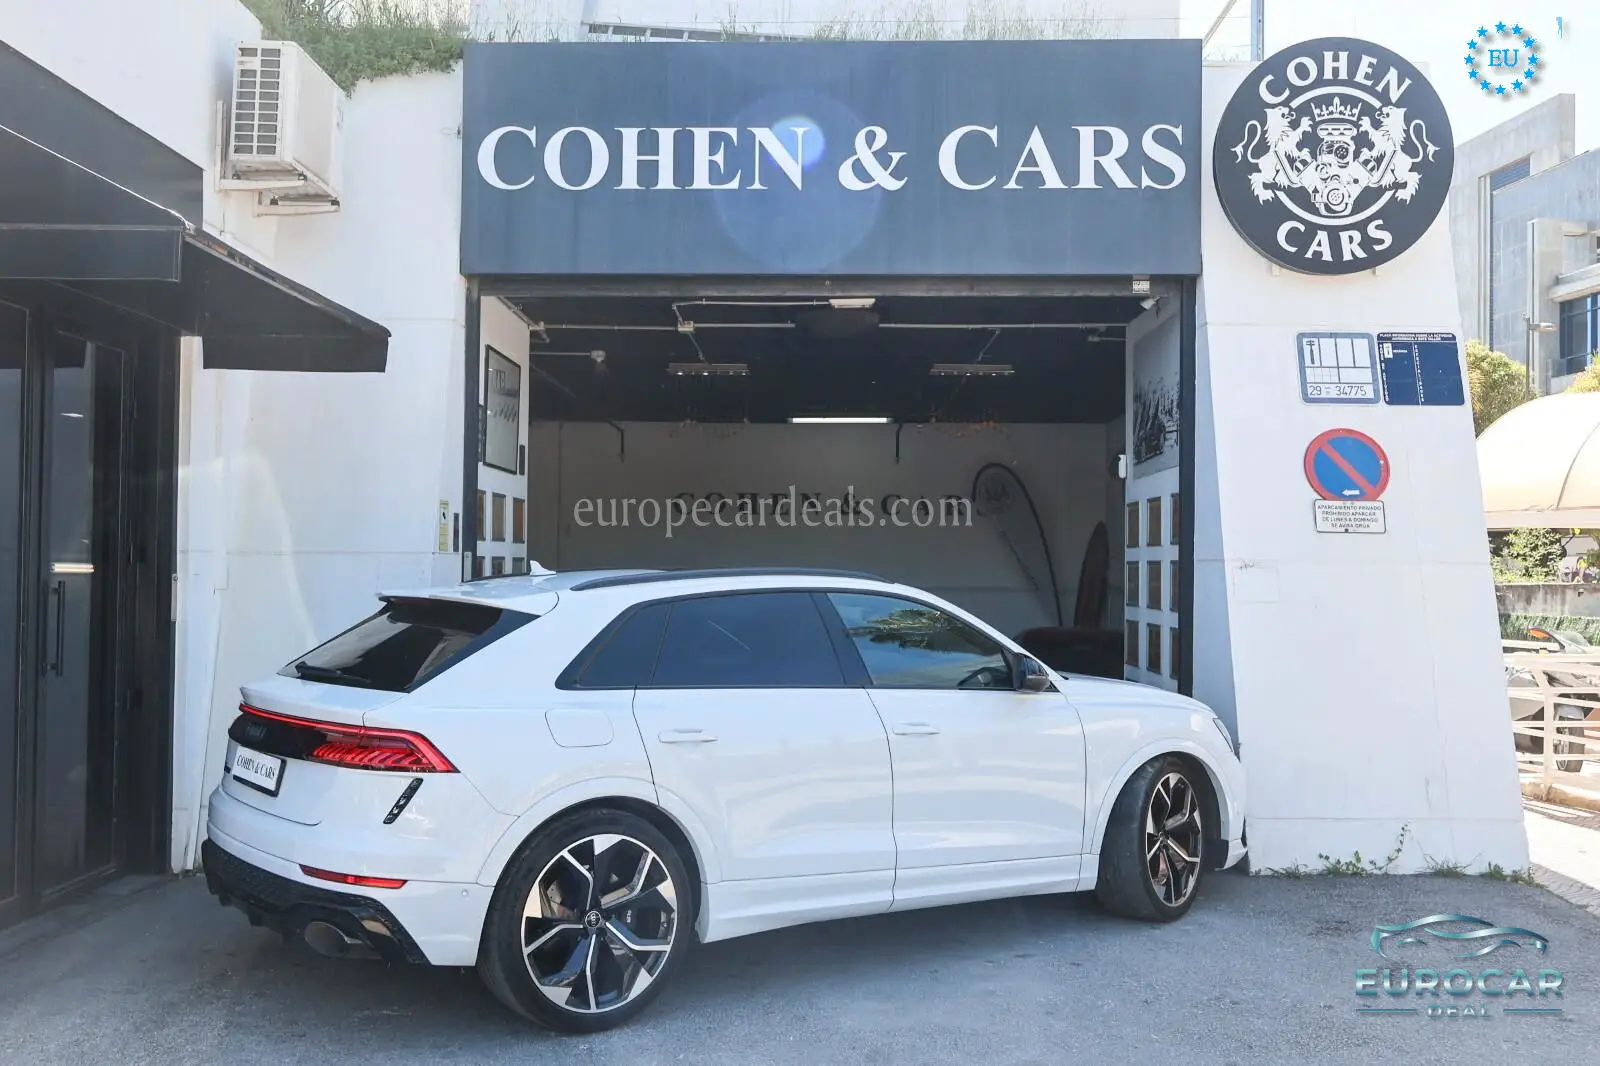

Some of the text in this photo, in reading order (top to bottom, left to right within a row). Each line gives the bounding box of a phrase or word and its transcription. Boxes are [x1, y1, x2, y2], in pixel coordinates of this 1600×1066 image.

[1258, 50, 1413, 105] COHEN
[477, 124, 1186, 191] COHEN & CARS
[1276, 219, 1393, 262] CARS
[1309, 385, 1322, 396] 29
[1335, 385, 1367, 397] 34775
[236, 754, 255, 772] COHEN
[260, 763, 276, 780] CARS
